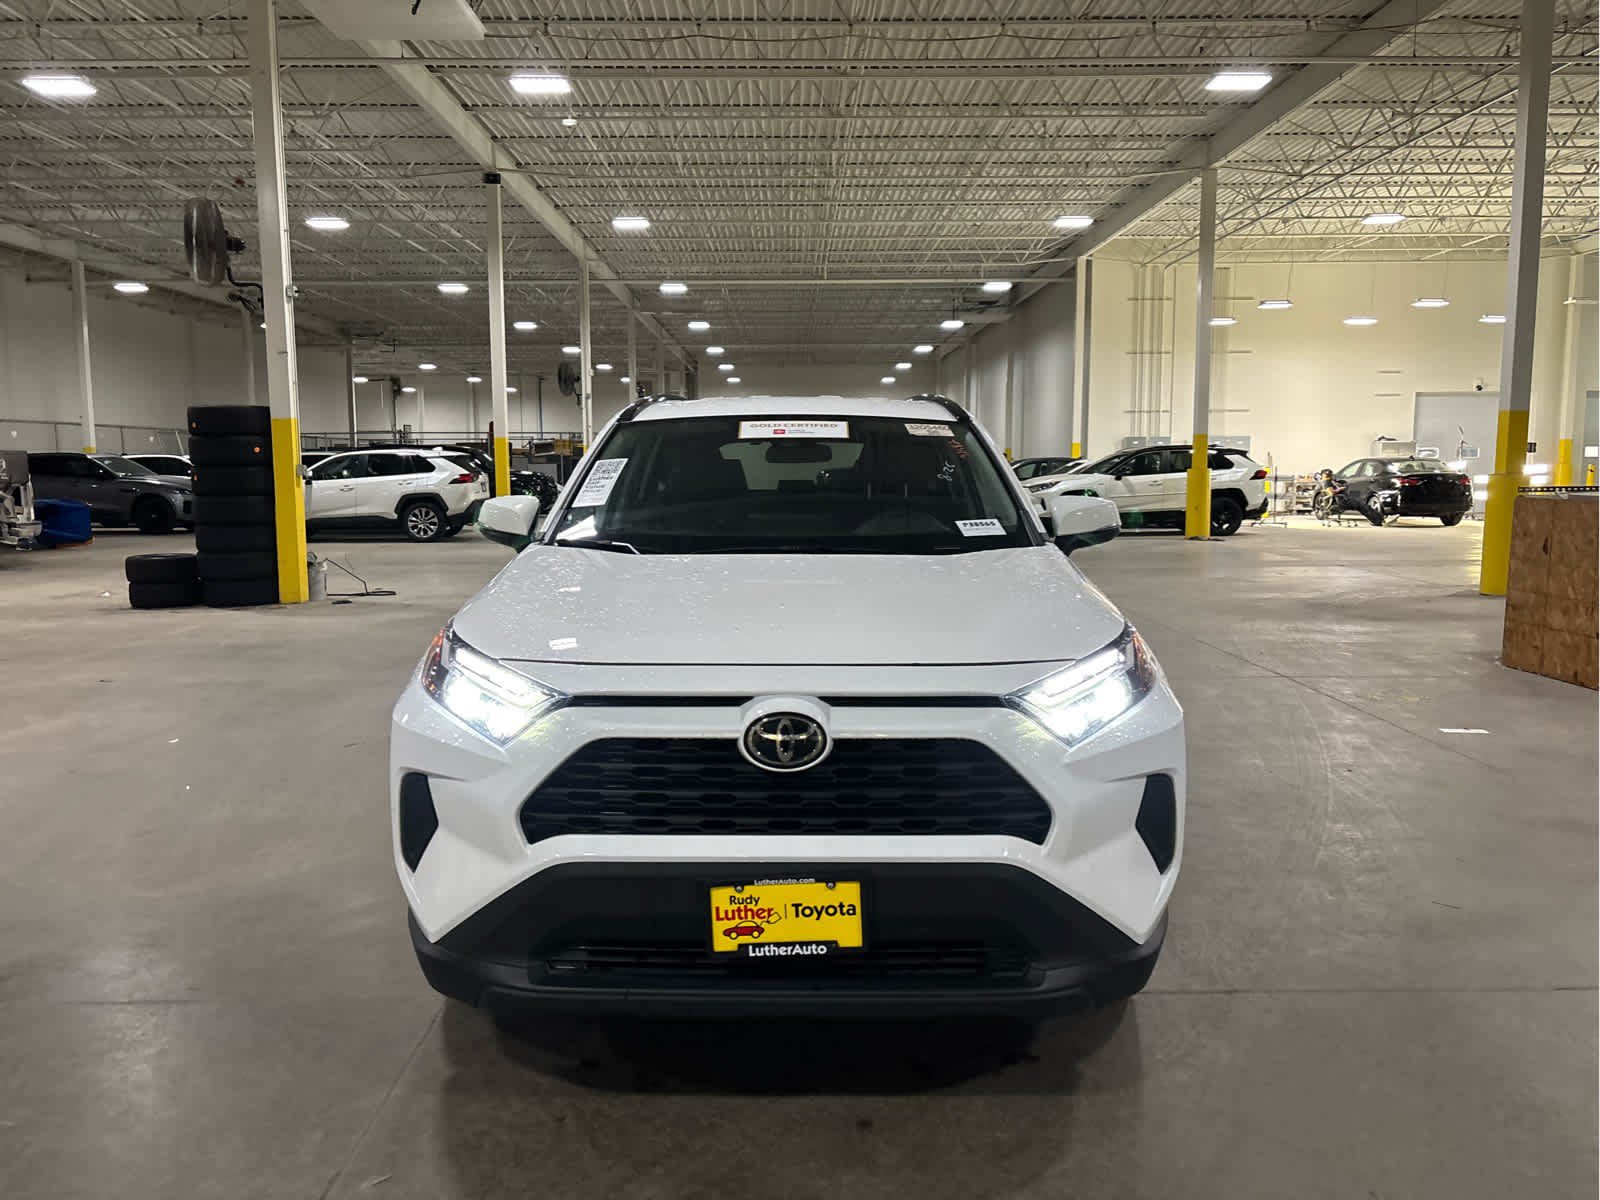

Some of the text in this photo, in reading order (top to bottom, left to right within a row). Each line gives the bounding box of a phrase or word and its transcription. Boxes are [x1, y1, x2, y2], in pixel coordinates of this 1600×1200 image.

[754, 877, 816, 886] LutherAuto.com
[729, 895, 760, 906] Rudy
[715, 901, 857, 922] Luther Toyota
[748, 944, 828, 957] LutherAuto
